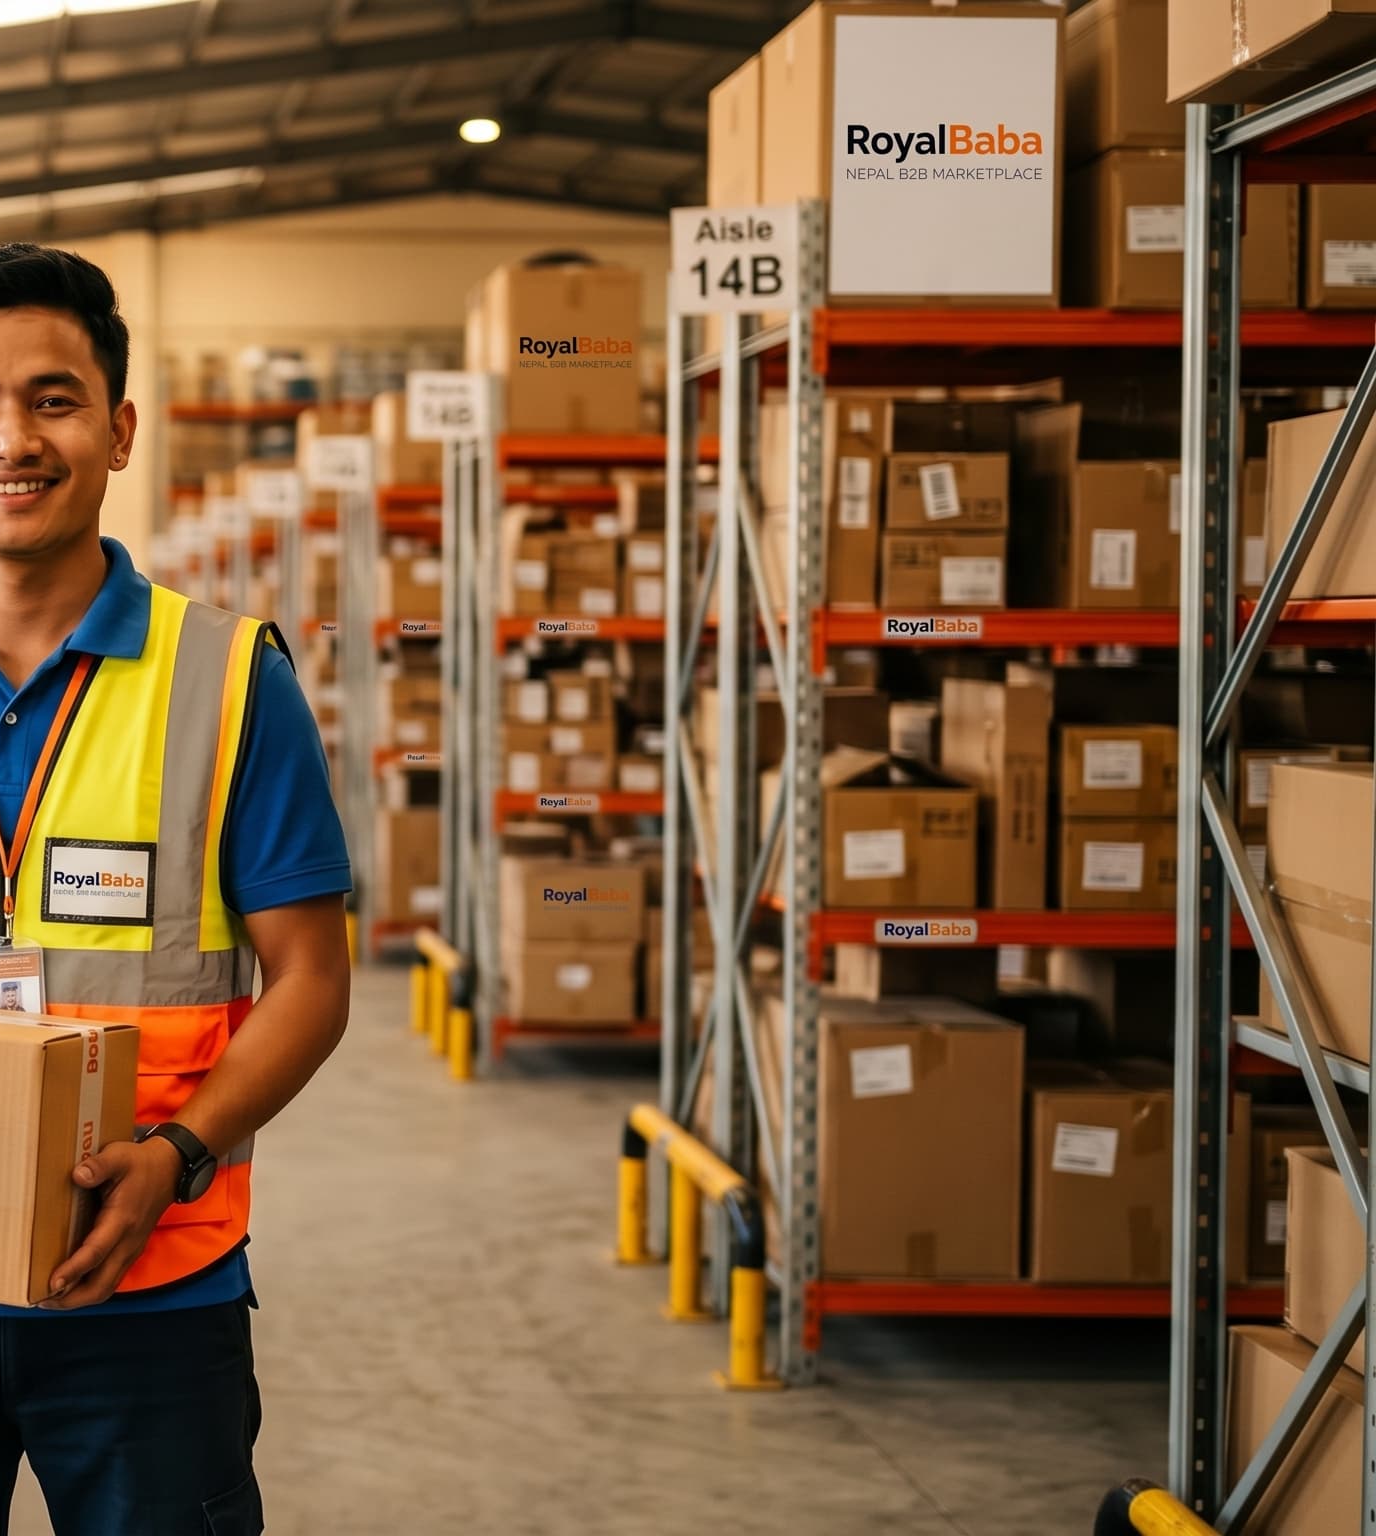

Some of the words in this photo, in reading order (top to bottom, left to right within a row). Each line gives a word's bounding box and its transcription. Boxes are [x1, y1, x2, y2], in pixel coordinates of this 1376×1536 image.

[846, 123, 1044, 164] RoyalBaba
[845, 167, 895, 180] NEPAL
[899, 167, 928, 180] B2B
[932, 167, 1043, 180] MARKETPLACE
[694, 215, 774, 242] Aisle
[690, 254, 783, 297] 14B
[519, 336, 633, 359] RoyalBaba
[887, 618, 978, 636] RoyalBaba
[53, 871, 145, 889] RoyalBaba
[884, 922, 972, 940] RoyalBaba
